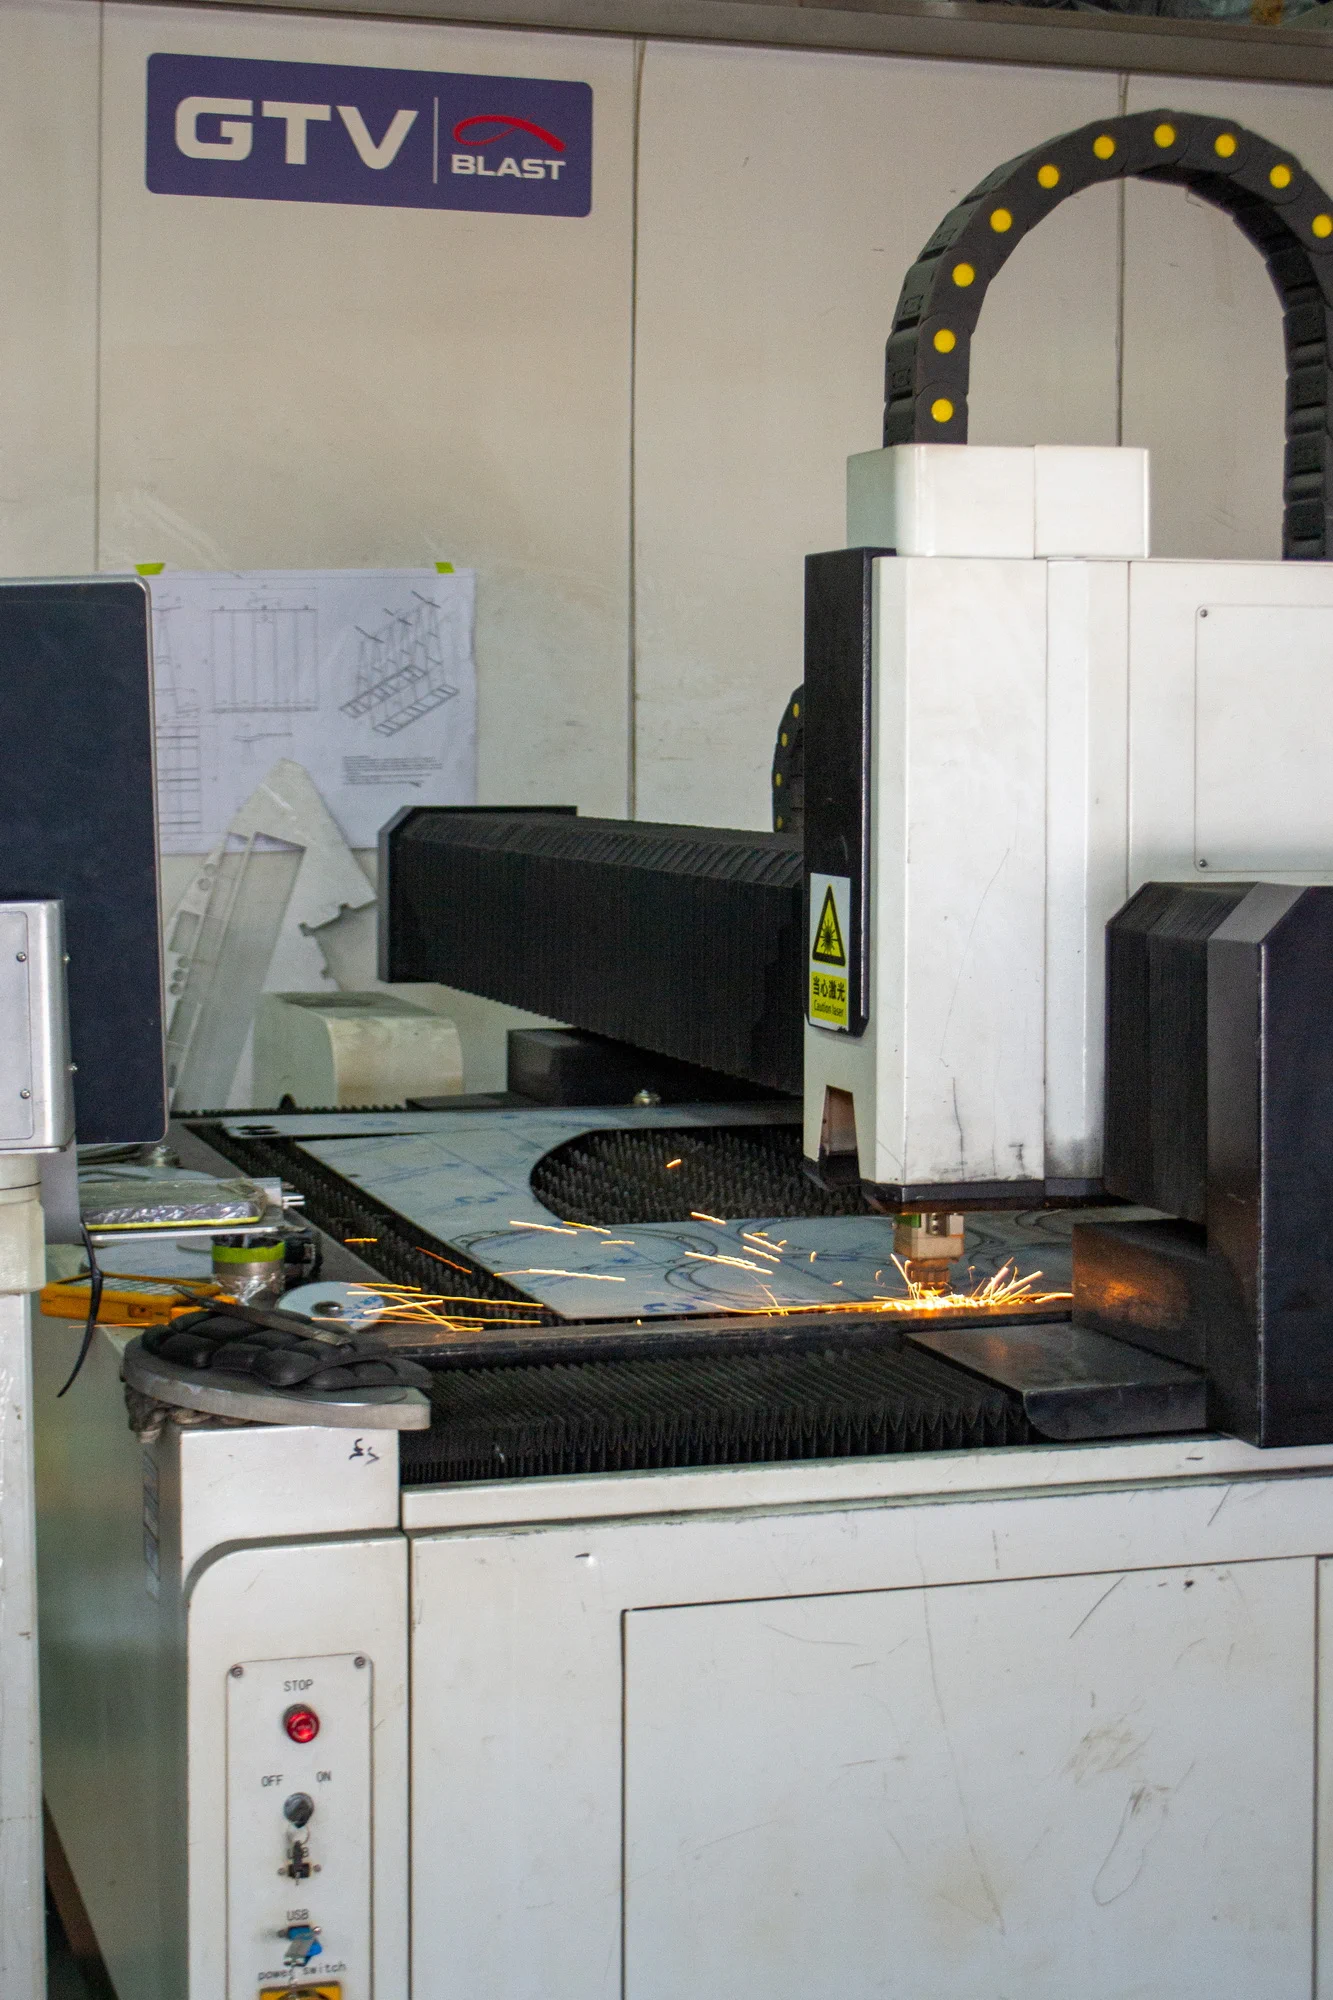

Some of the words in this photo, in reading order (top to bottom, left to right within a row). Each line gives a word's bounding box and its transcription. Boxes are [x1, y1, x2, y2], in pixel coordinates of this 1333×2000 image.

[175, 95, 418, 169] GTV
[451, 153, 566, 180] BLAST
[813, 976, 845, 1002] 当心激光
[814, 999, 832, 1014] Caution
[283, 1679, 313, 1692] STOP
[261, 1774, 283, 1787] OFF
[316, 1771, 331, 1782] ON
[287, 1847, 309, 1859] UB
[287, 1908, 309, 1920] USB
[303, 1960, 346, 1975] switch
